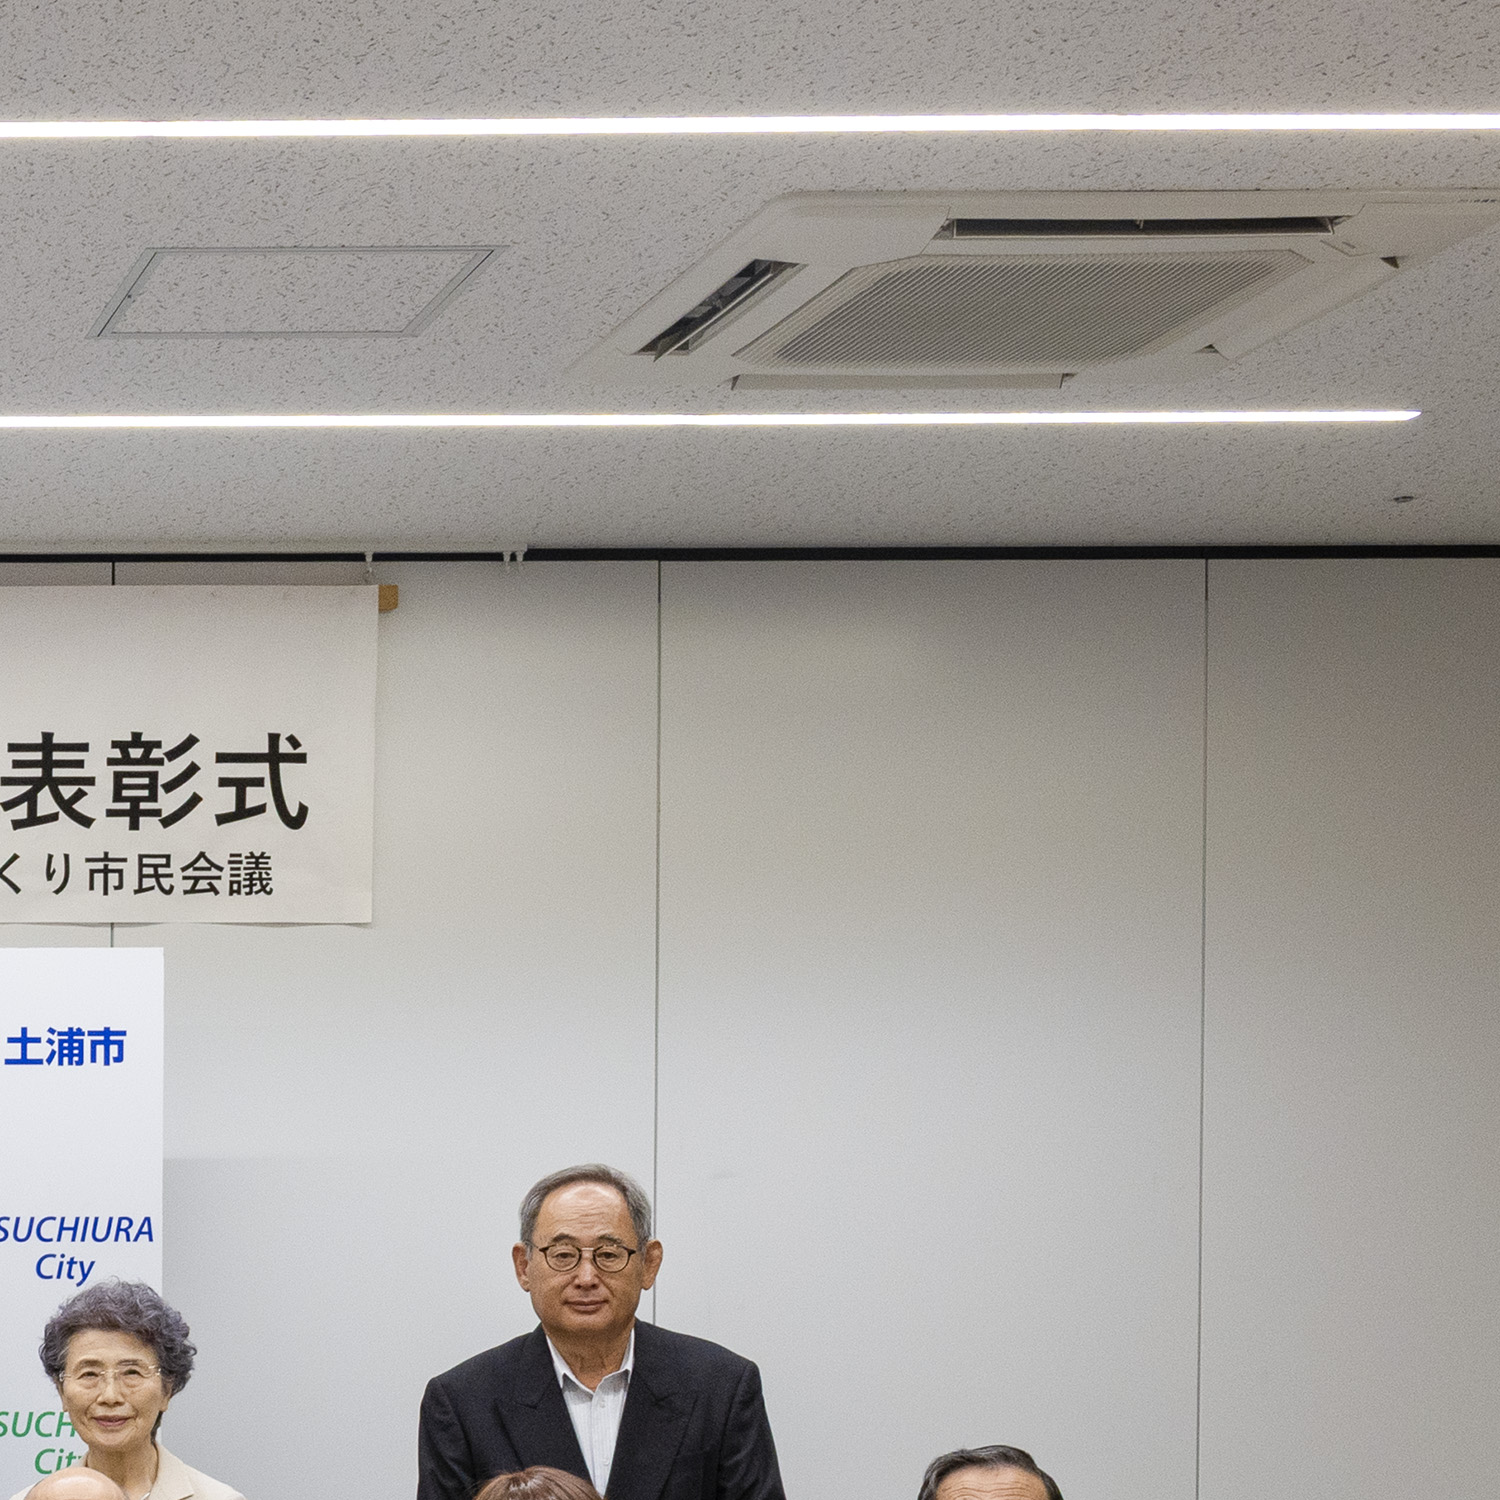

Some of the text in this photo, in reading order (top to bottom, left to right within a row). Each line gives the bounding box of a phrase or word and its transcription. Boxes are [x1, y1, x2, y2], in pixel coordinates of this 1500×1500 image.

[0, 732, 308, 830] 表彰式
[4, 1027, 127, 1066] 土浦市
[36, 1254, 95, 1286] City
[34, 1448, 82, 1475] Cit
